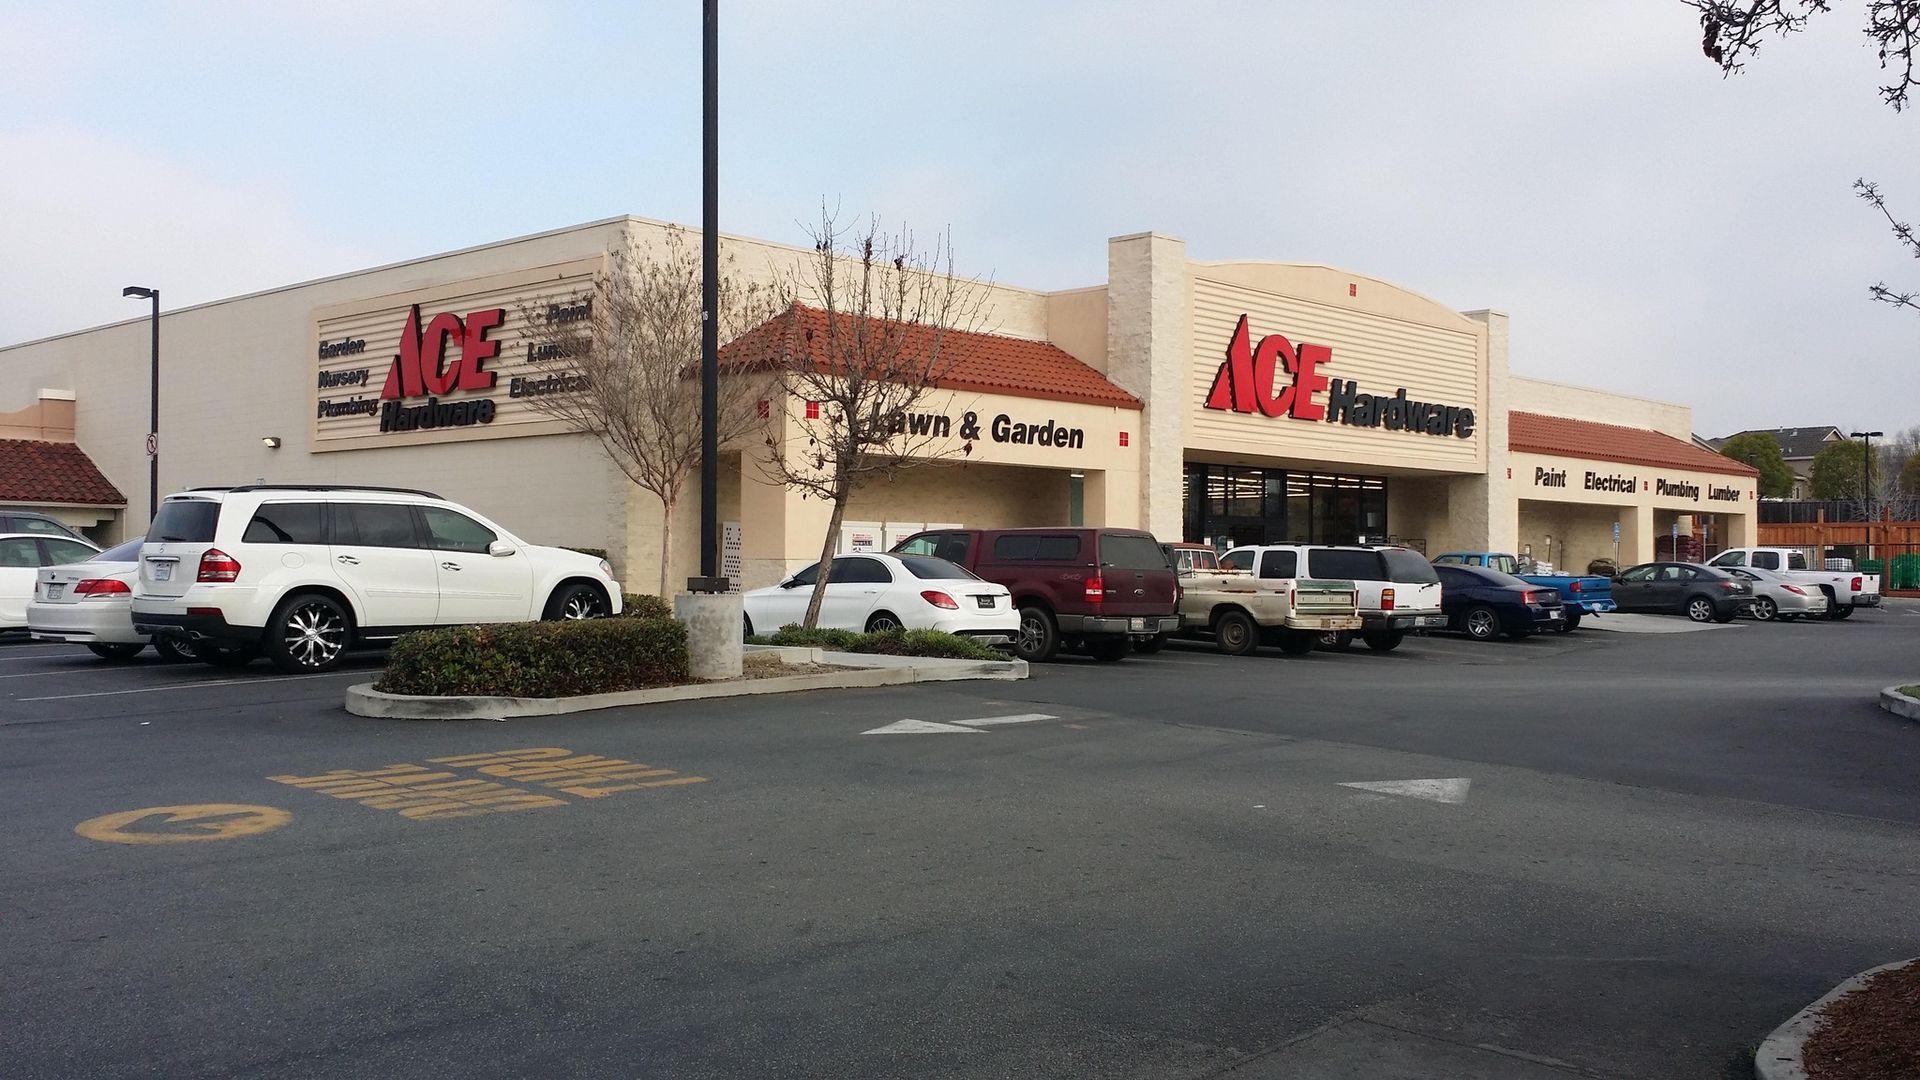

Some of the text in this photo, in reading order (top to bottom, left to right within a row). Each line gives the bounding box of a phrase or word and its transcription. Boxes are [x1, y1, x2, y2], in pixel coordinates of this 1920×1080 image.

[318, 337, 365, 360] Garden
[379, 304, 505, 399] ACE
[527, 338, 593, 362] Lum
[318, 368, 369, 388] Nursery
[1203, 313, 1475, 439] ACE Hardware
[317, 396, 378, 418] Plumbing
[380, 397, 495, 432] Hardware
[960, 411, 981, 440] &
[991, 413, 1084, 449] Garden
[1534, 467, 1637, 493] Paint Electrical
[1656, 478, 1740, 502] Plumbing Lumber
[425, 747, 708, 798] THRU
